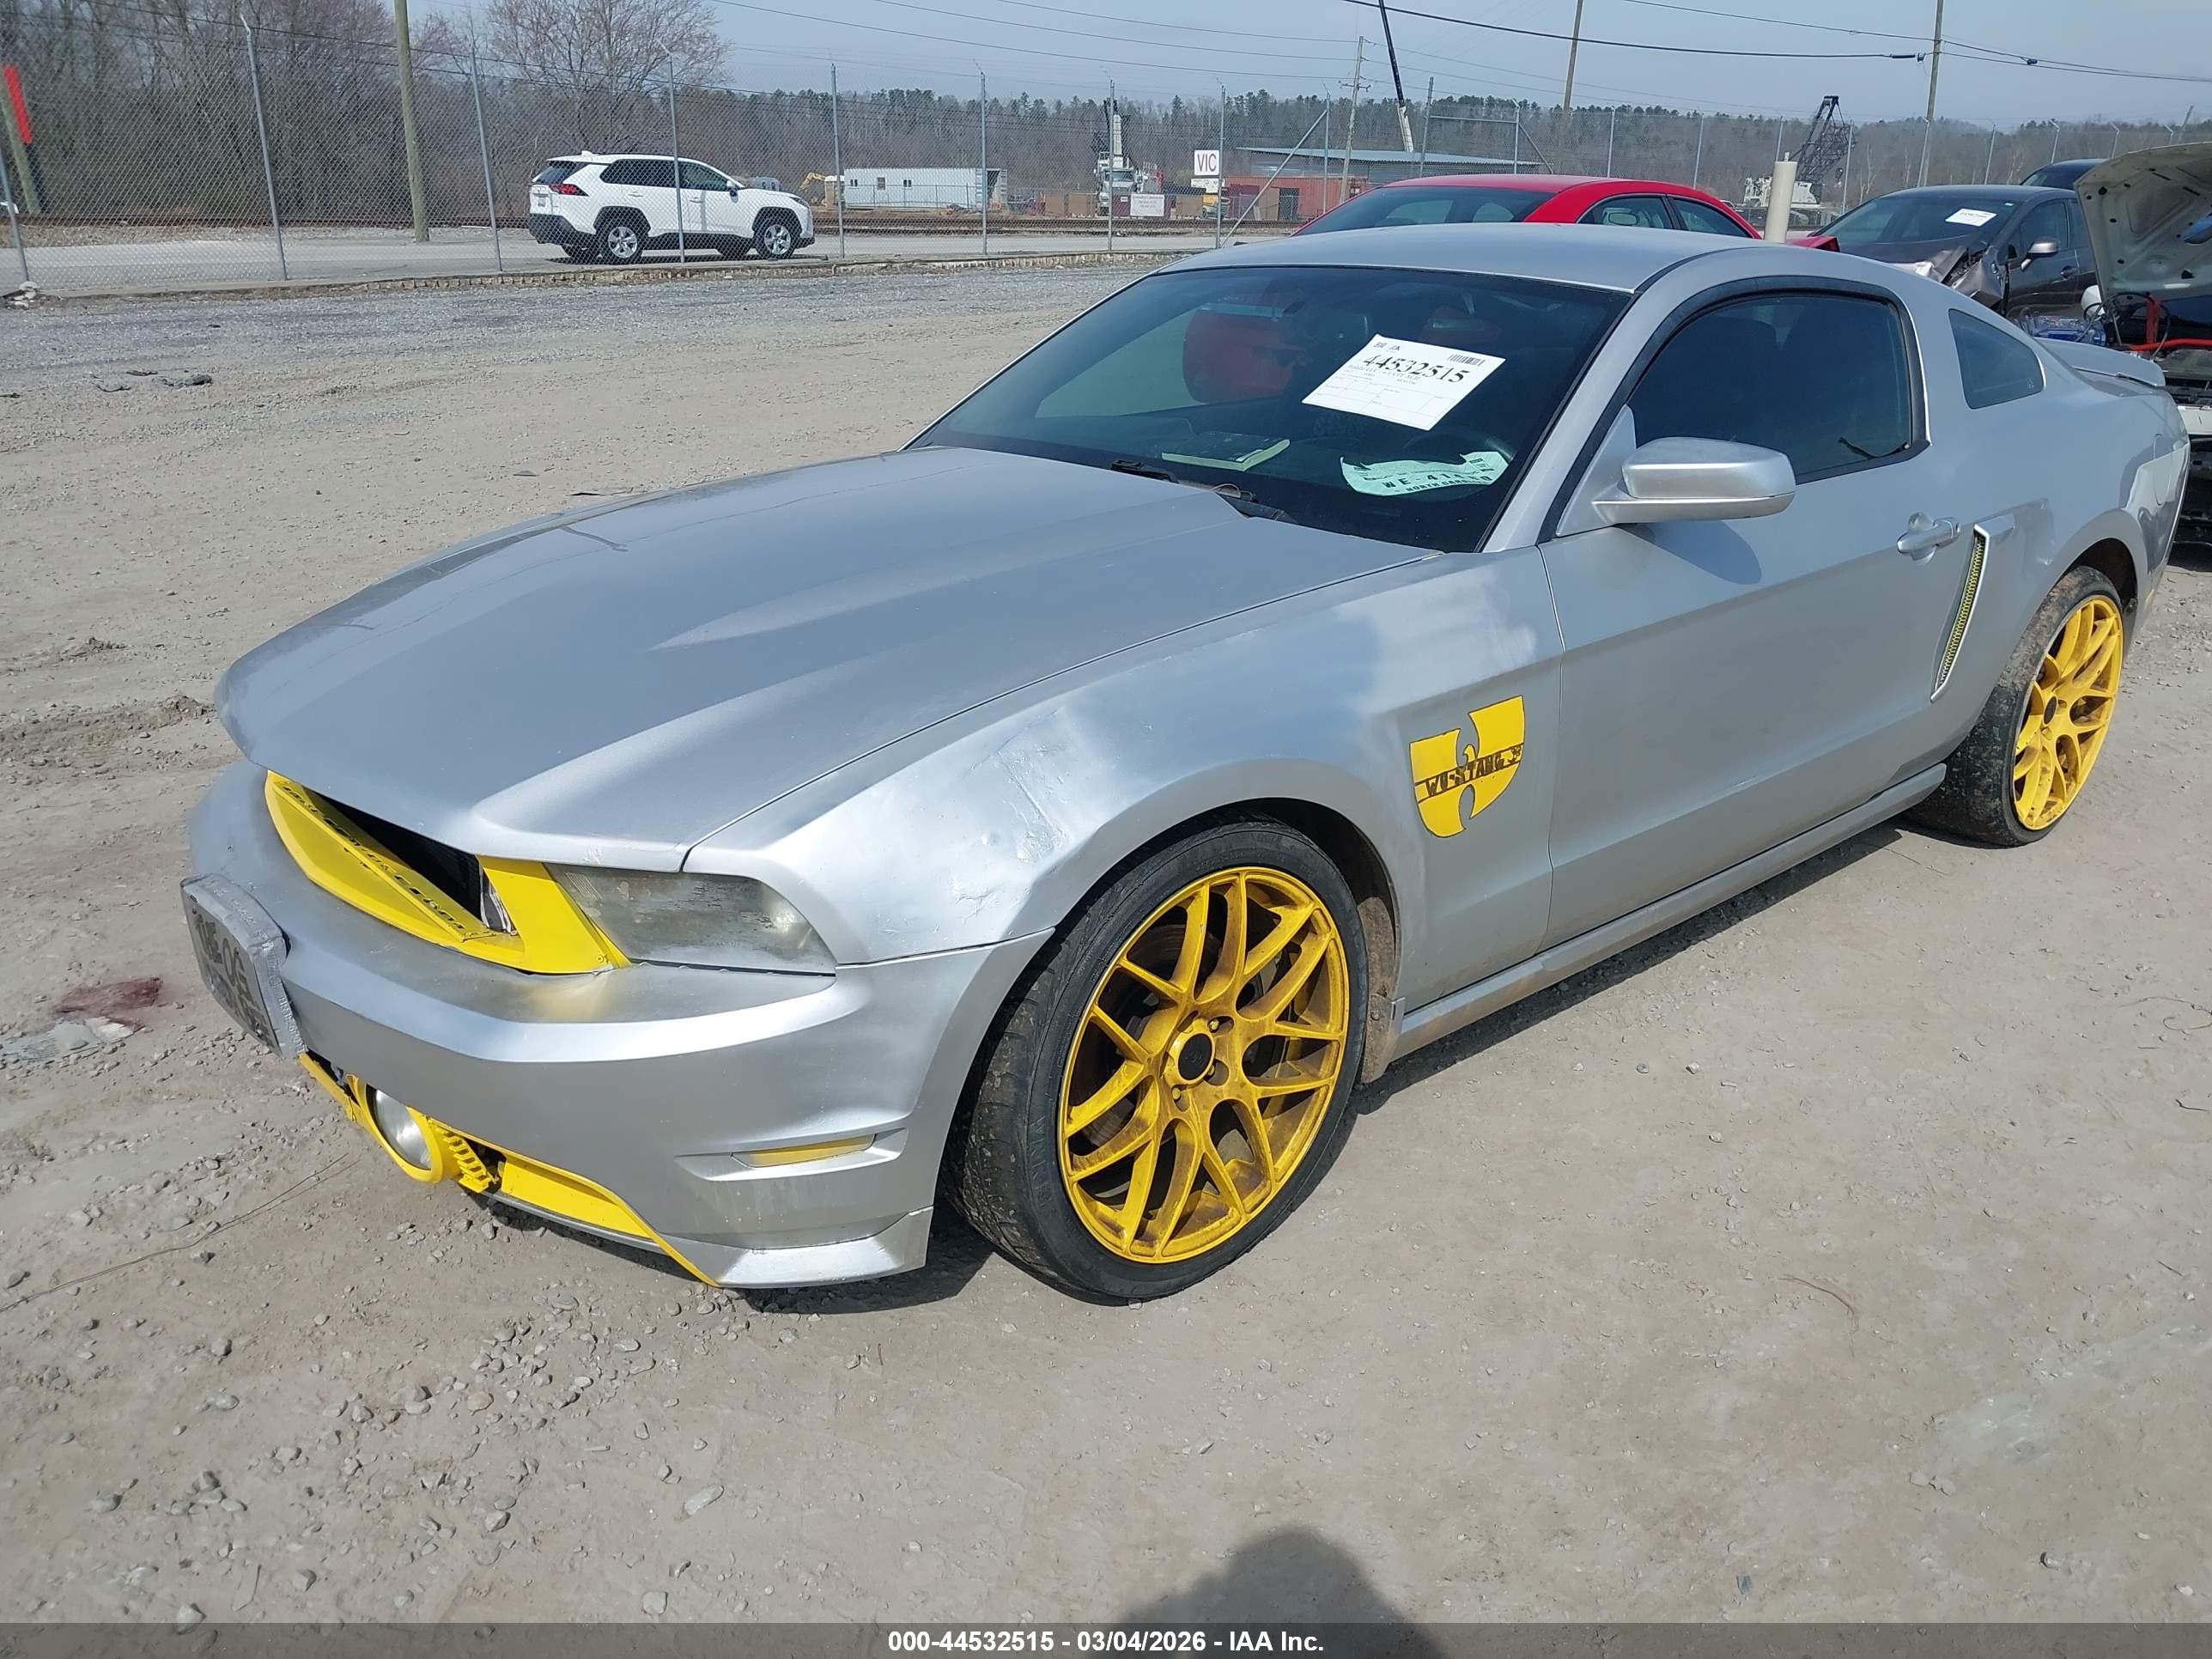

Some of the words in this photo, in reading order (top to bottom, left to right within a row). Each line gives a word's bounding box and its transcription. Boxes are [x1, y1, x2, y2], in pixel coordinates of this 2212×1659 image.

[1197, 153, 1217, 173] VIC
[1363, 354, 1470, 383] 44532515
[1406, 479, 1441, 492] NORTH
